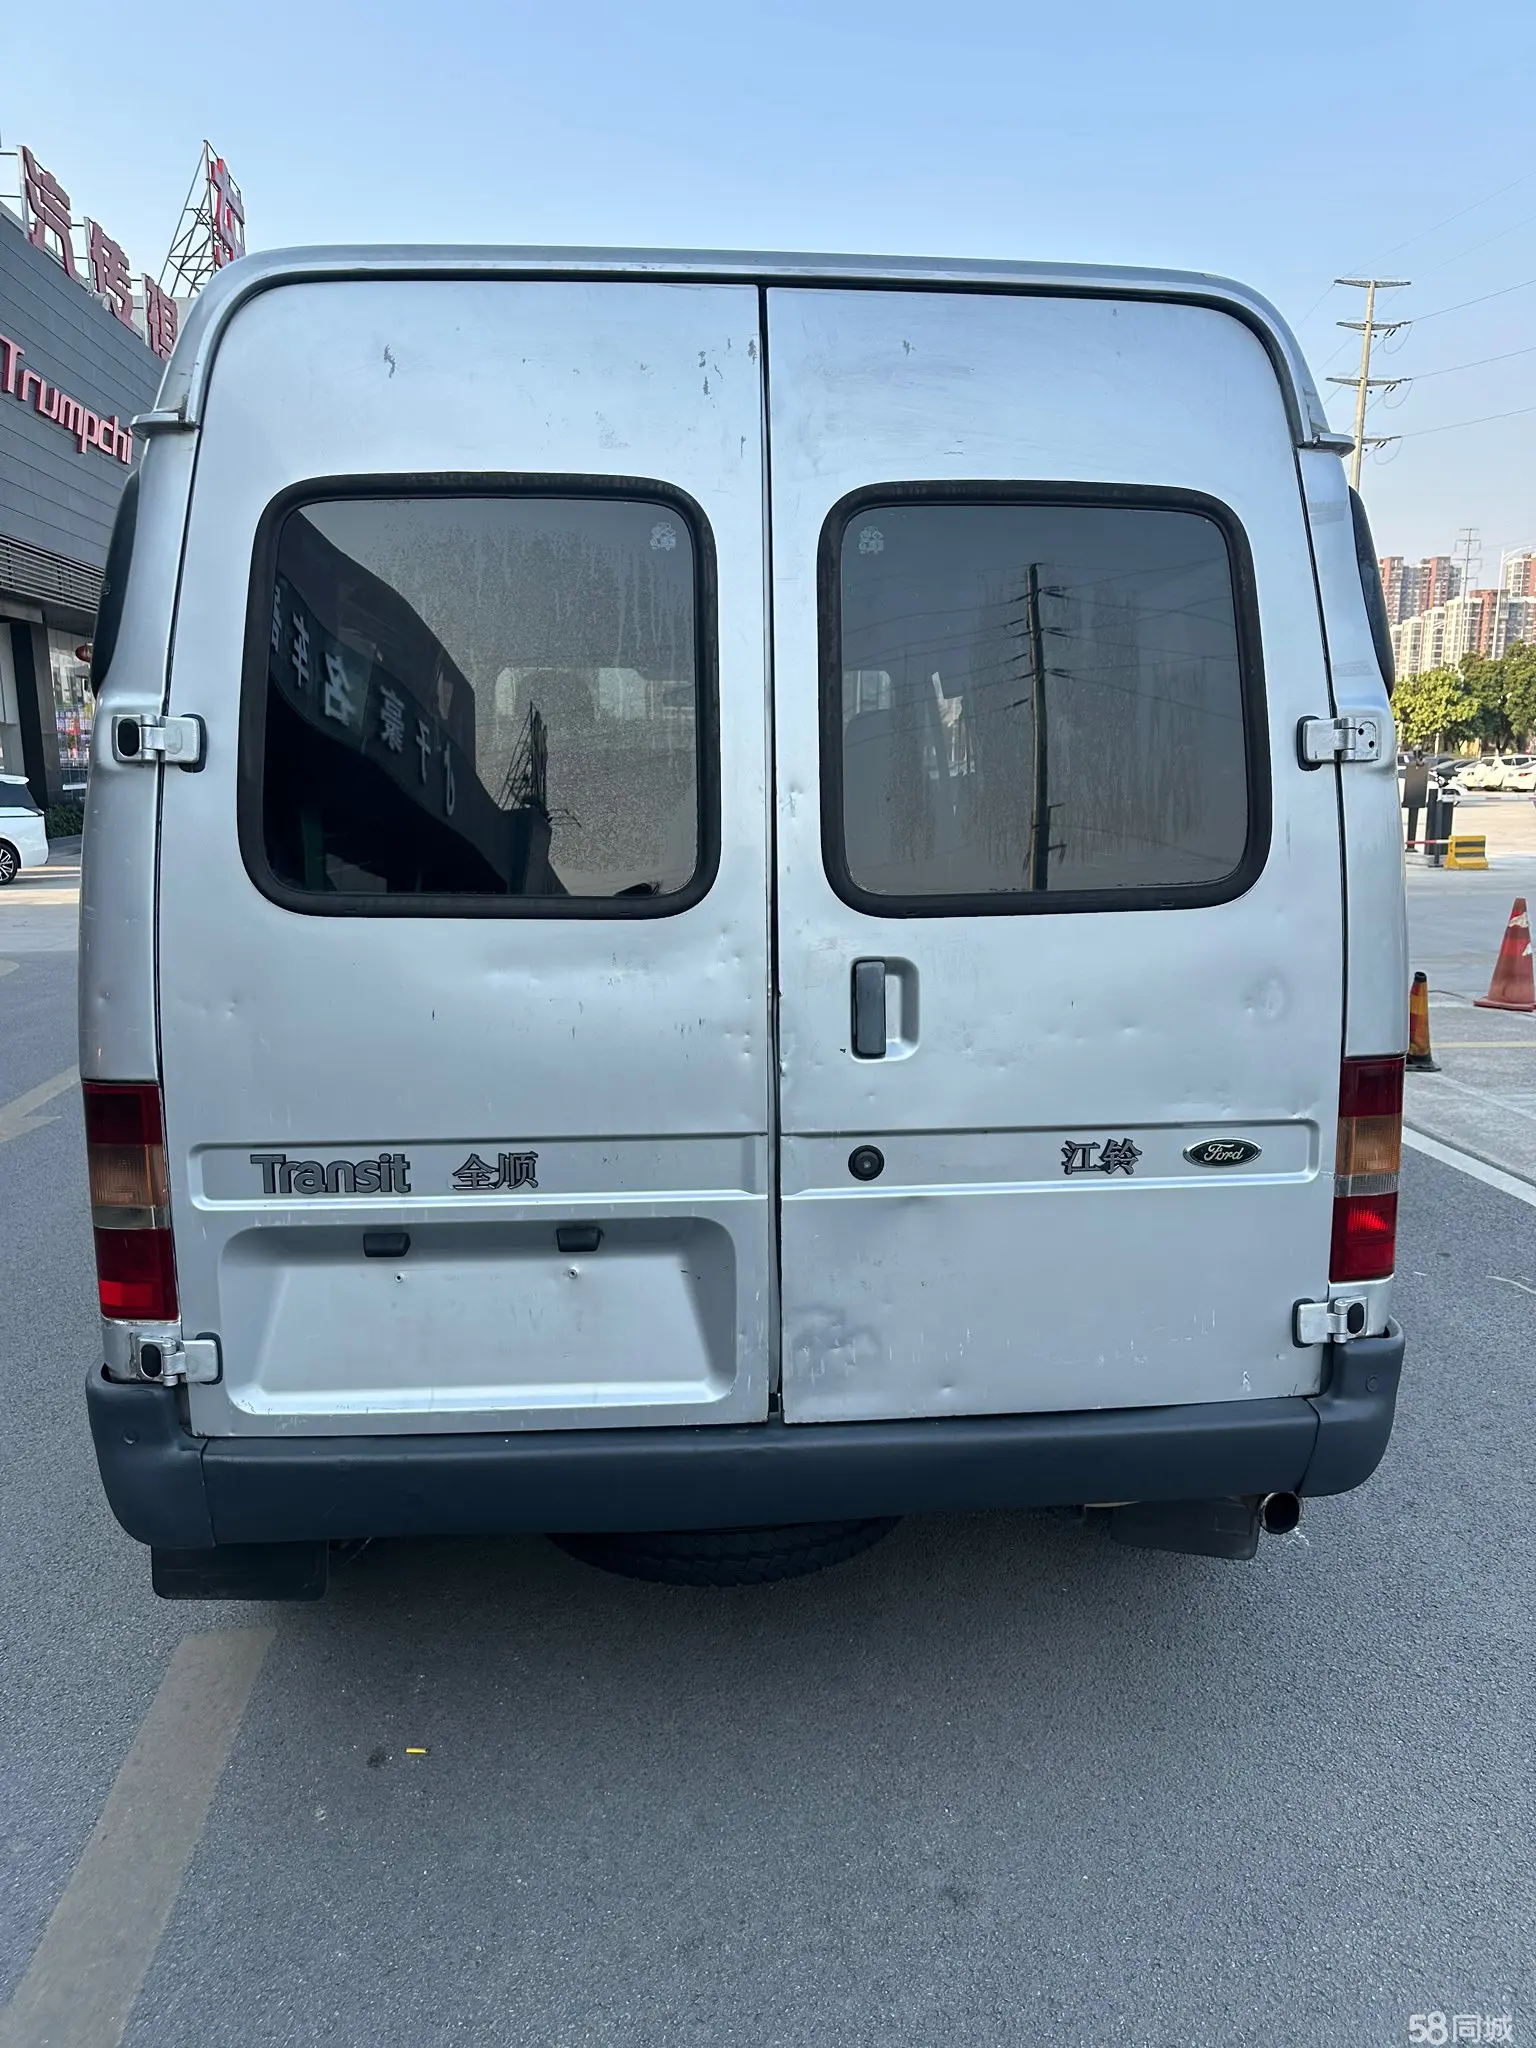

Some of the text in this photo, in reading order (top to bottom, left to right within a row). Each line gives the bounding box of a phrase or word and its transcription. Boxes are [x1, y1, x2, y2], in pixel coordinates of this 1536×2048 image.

[0, 334, 133, 465] Trumpchi
[453, 1151, 539, 1190] 全顺
[1061, 1138, 1143, 1175] 江铃
[1204, 1143, 1244, 1161] Ford
[250, 1153, 411, 1194] Transit
